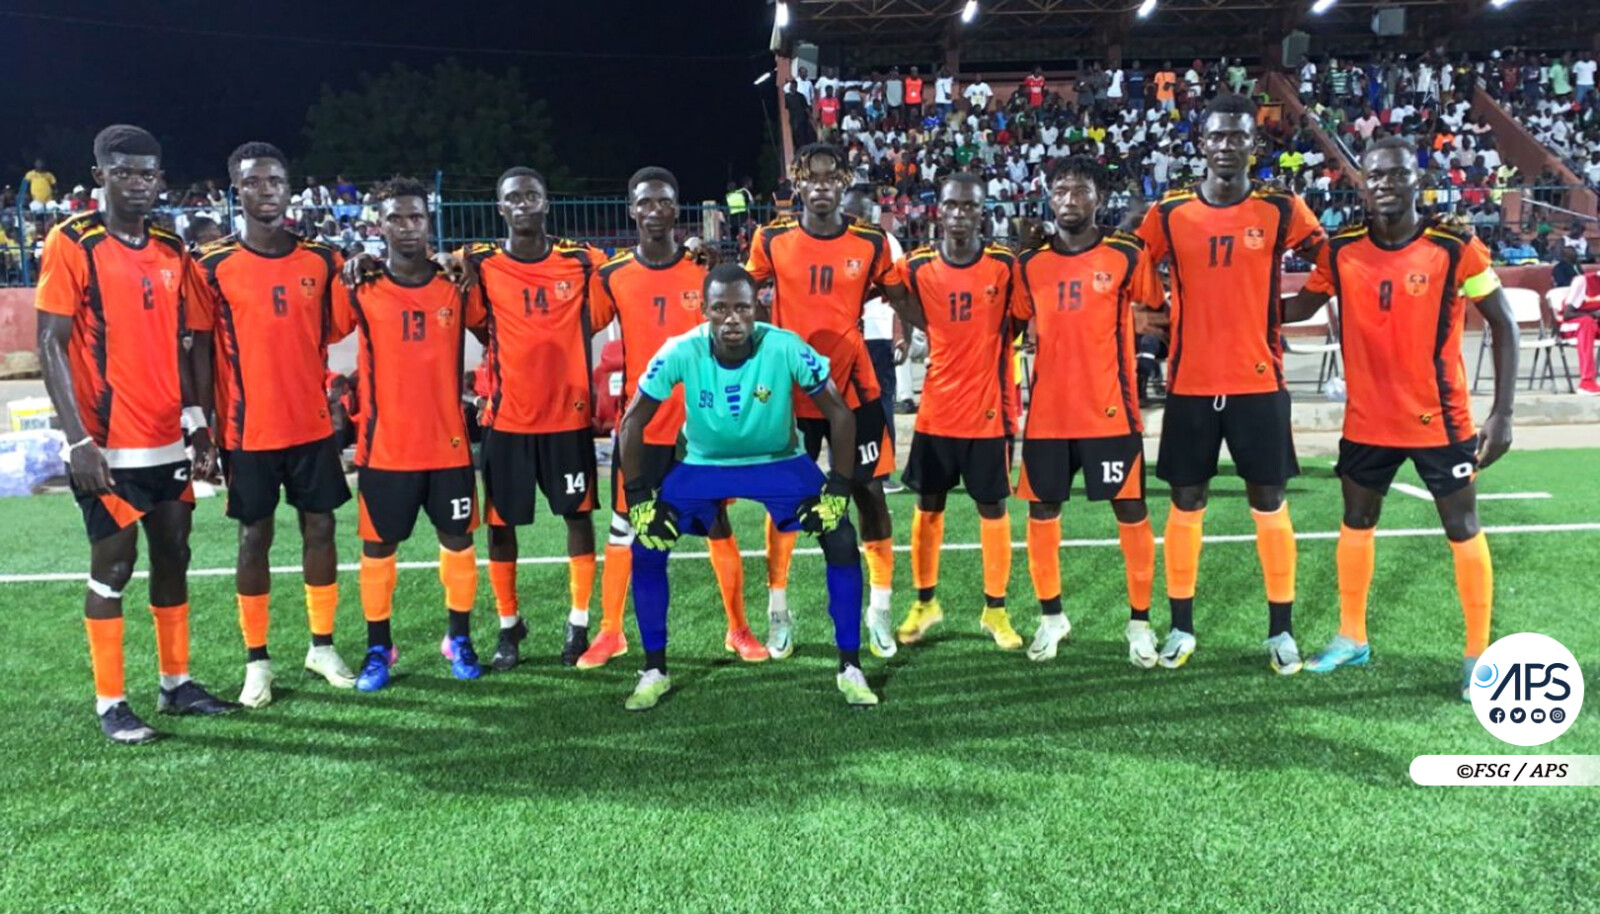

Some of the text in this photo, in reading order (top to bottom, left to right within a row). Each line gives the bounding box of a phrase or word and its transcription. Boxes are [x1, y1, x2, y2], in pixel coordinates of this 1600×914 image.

[1208, 236, 1233, 267] 17
[142, 276, 154, 310] 2
[808, 265, 833, 295] 10
[273, 286, 288, 316] 6
[522, 287, 549, 316] 14
[949, 293, 973, 321] 12
[1057, 280, 1083, 310] 15
[402, 311, 426, 341] 13
[654, 297, 666, 326] 7
[859, 442, 879, 465] 10
[565, 472, 586, 495] 14
[1102, 461, 1124, 482] 15
[451, 498, 471, 521] 13
